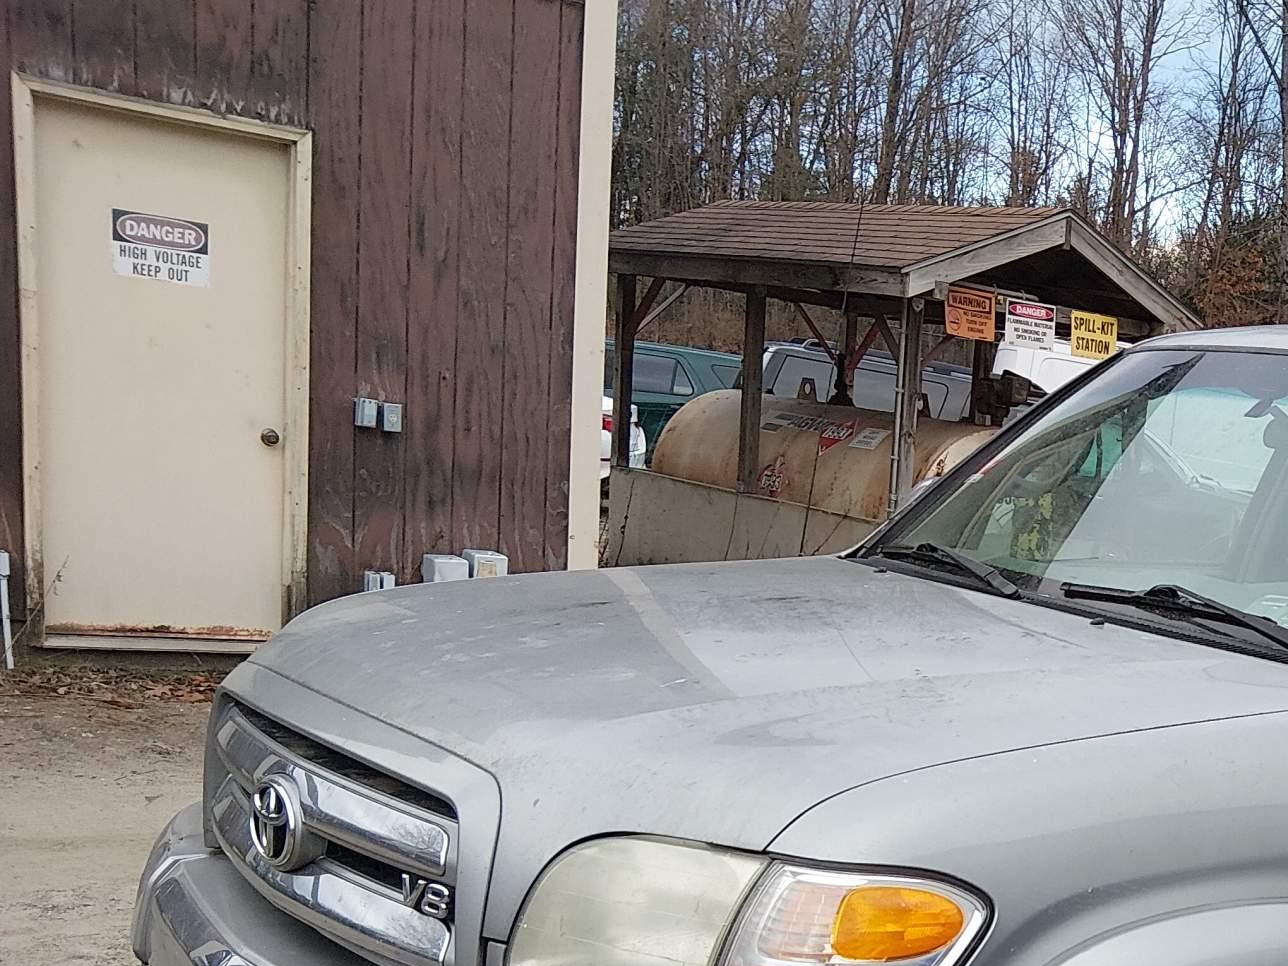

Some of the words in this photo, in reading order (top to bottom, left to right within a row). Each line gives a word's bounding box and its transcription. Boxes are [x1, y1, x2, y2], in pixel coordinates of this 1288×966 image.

[125, 220, 197, 245] DANGER
[119, 244, 147, 261] HIGH
[154, 249, 203, 269] VOLTAGE
[132, 262, 161, 278] KEEP
[168, 268, 190, 282] OUT
[951, 294, 987, 310] WARNING
[1016, 305, 1046, 318] DANGER
[1073, 316, 1114, 336] SPILL-KIT
[1075, 336, 1110, 355] STATION
[401, 873, 450, 919] V8
